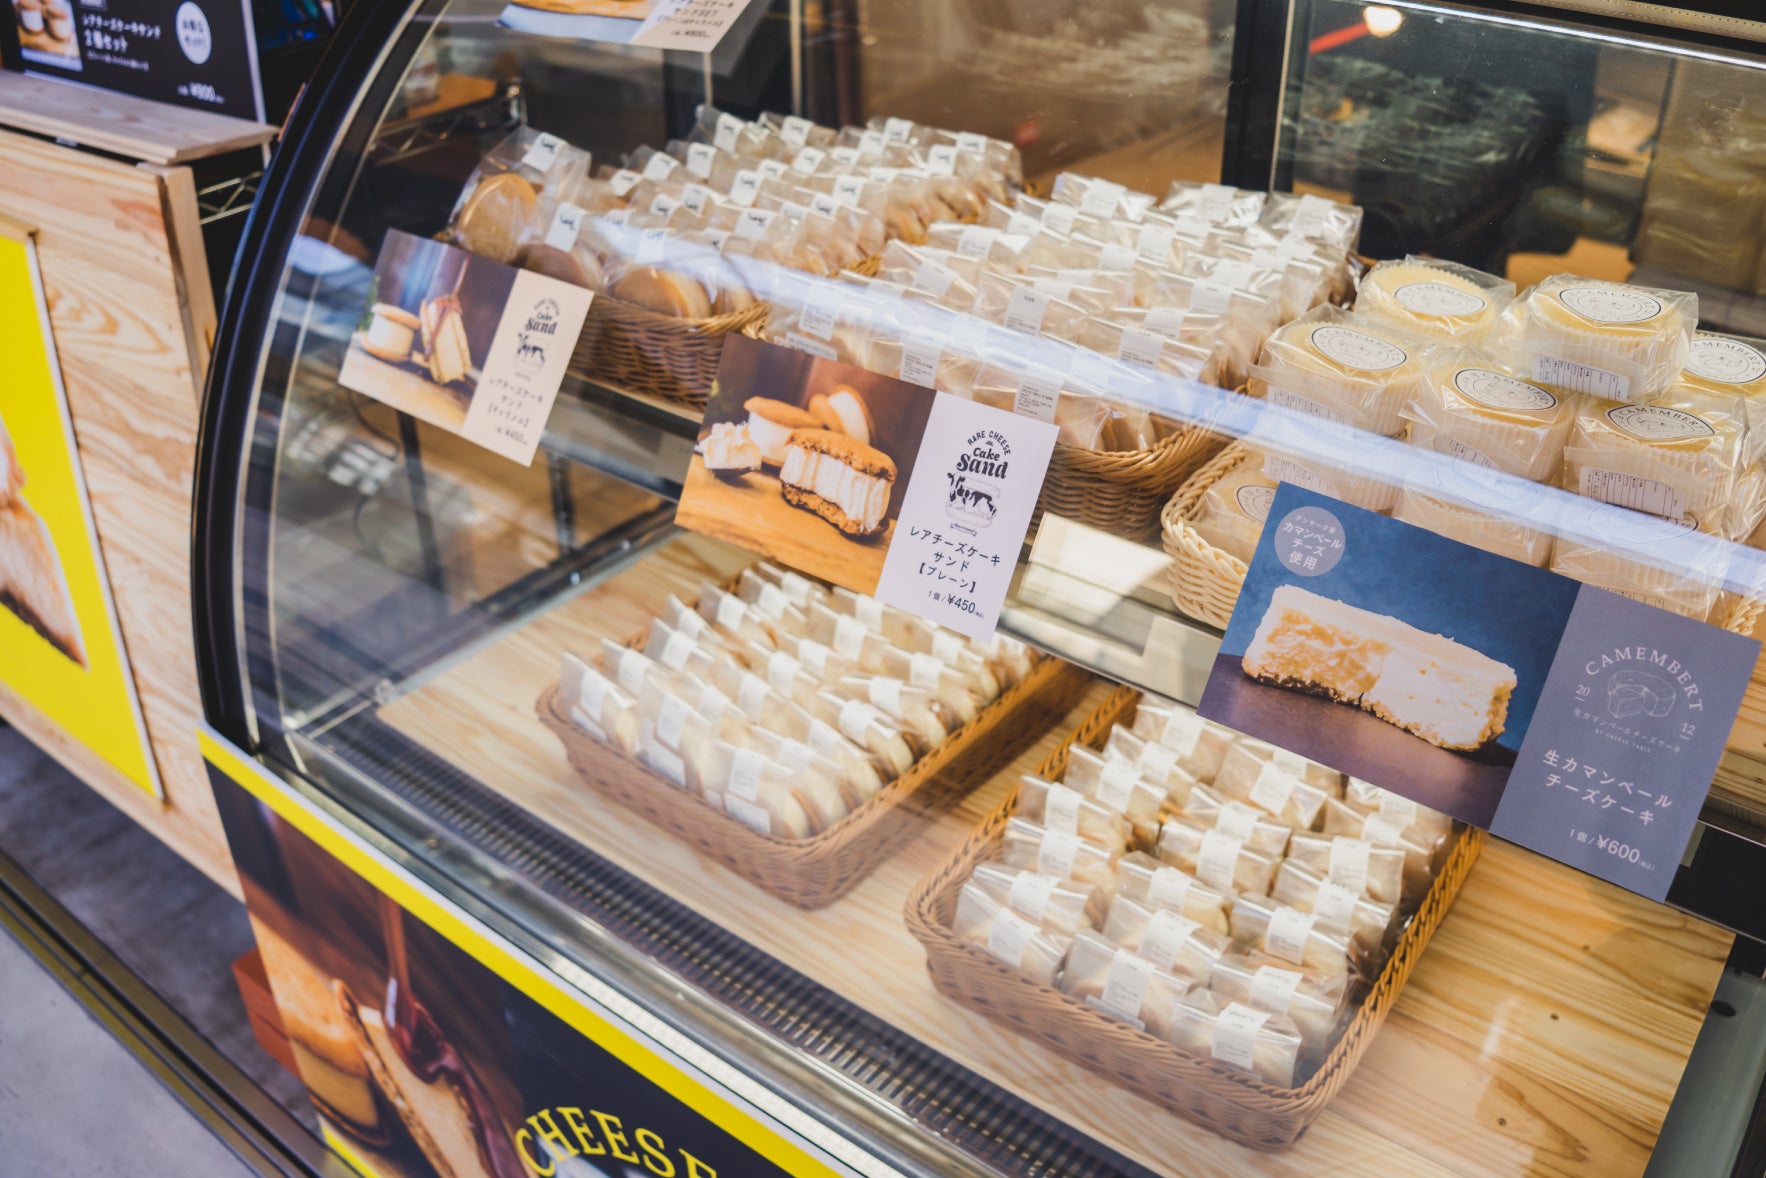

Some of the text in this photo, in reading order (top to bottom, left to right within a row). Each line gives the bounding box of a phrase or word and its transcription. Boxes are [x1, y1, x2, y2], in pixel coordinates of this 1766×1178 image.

[525, 317, 558, 335] Sand
[967, 430, 1012, 455] RARE CHEESE
[973, 447, 1000, 461] Cake
[956, 453, 1008, 479] Sand
[910, 525, 1001, 567] レアチーズケーキ
[1283, 521, 1342, 549] カマンベール
[1292, 537, 1326, 557] チーズ
[933, 550, 970, 572] サンド
[1289, 550, 1318, 570] 使用
[1576, 684, 1591, 697] 20
[1585, 646, 1703, 713] CAMEMBERT
[1681, 721, 1696, 736] 12
[1543, 749, 1673, 809] 生カマンベール
[1546, 773, 1655, 826] チーズケーキ
